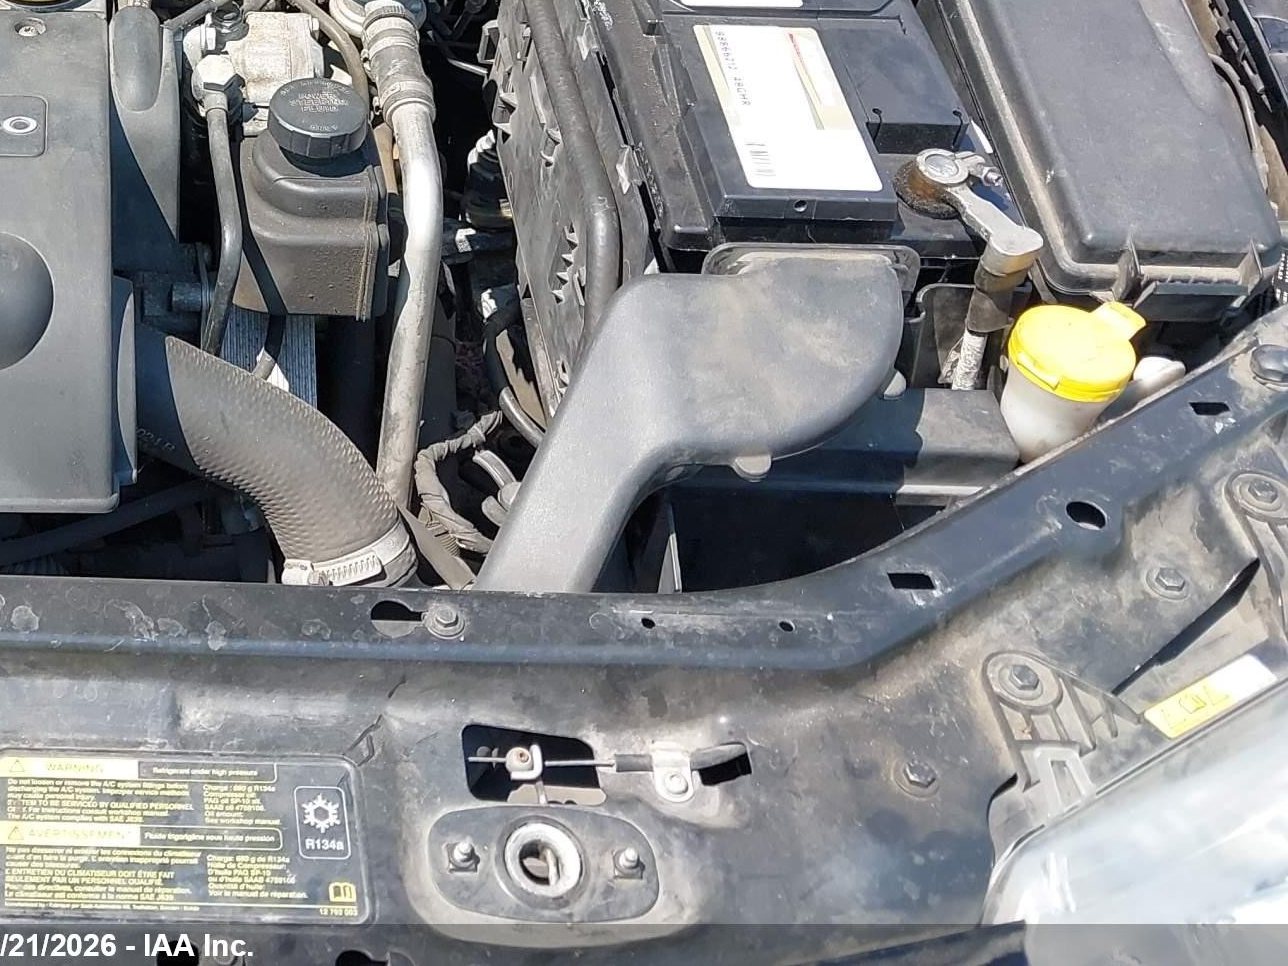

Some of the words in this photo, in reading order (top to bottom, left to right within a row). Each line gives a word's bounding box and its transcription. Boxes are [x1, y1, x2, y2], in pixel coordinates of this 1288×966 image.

[298, 91, 338, 99] POWER
[289, 98, 350, 106] STEERING
[305, 839, 345, 850] R134a
